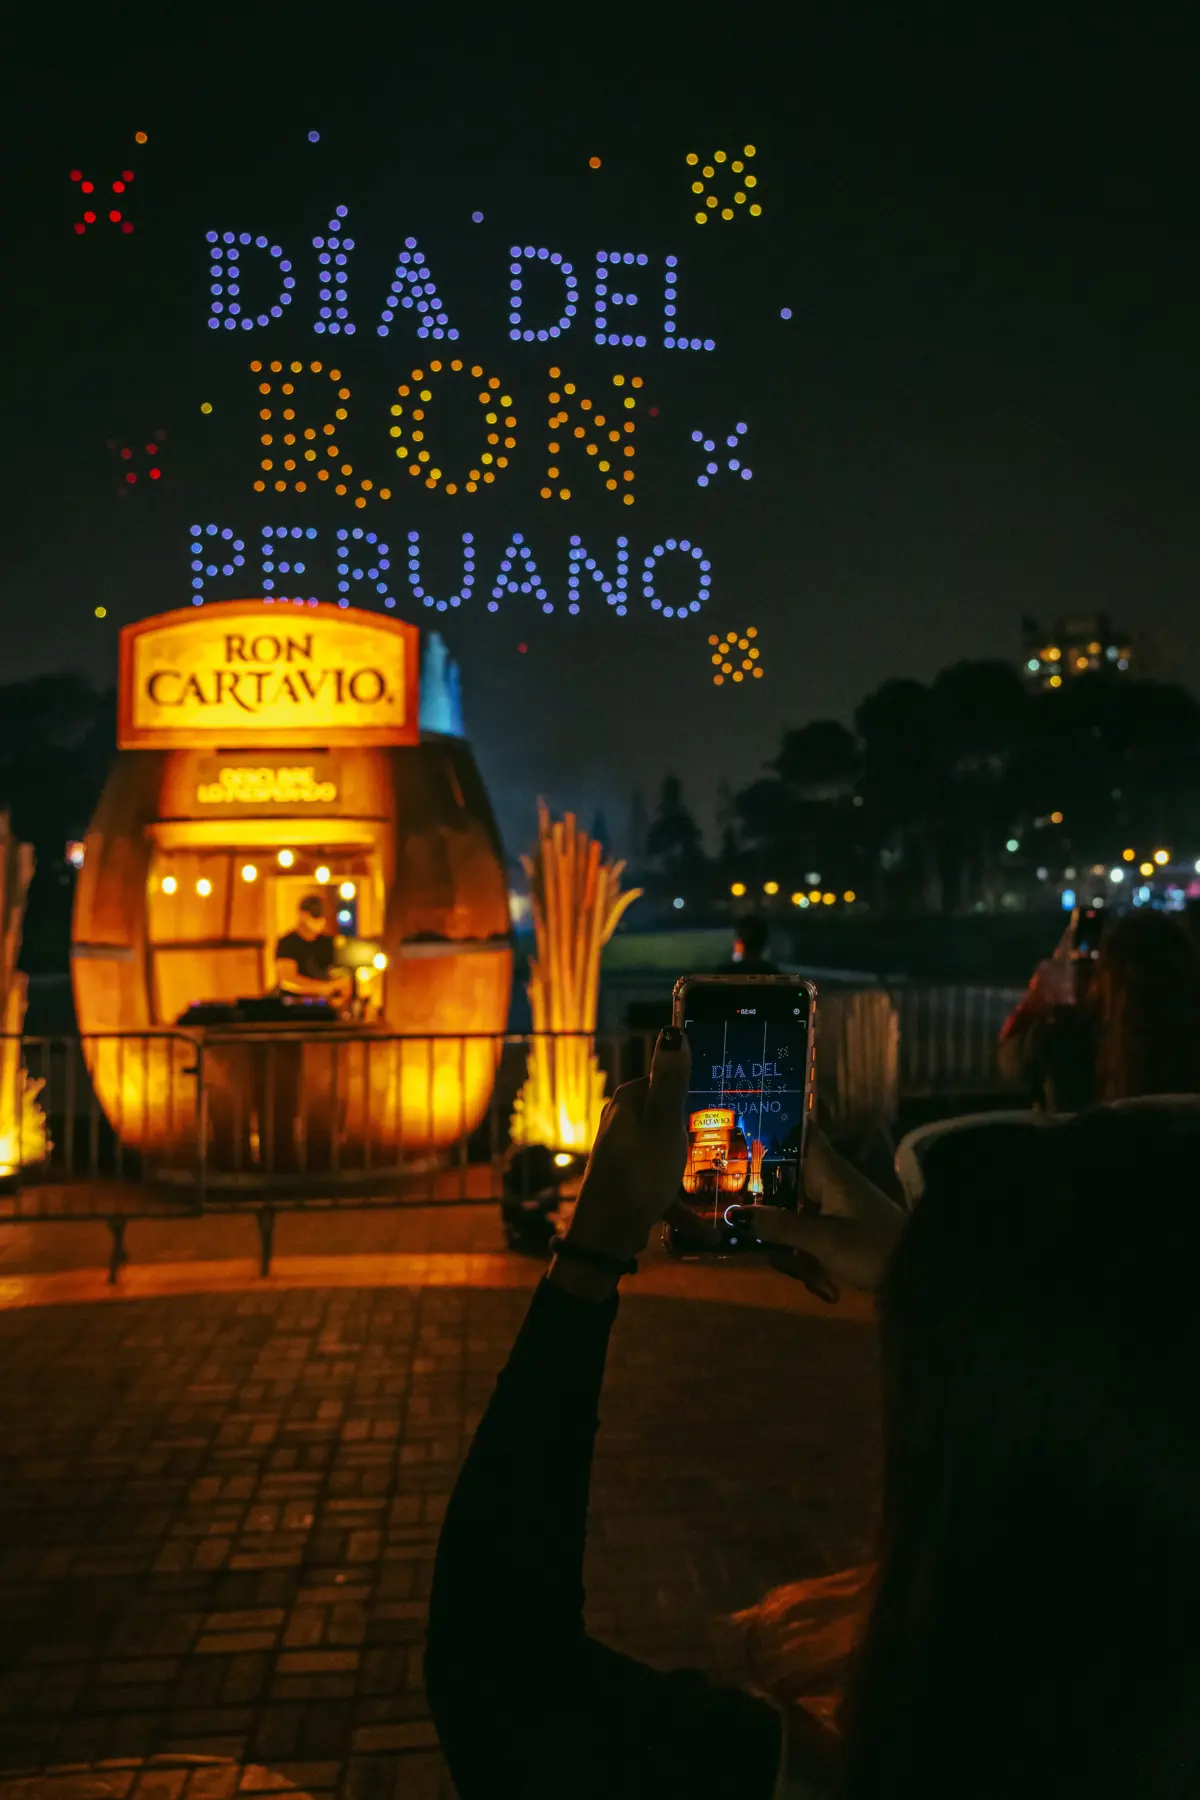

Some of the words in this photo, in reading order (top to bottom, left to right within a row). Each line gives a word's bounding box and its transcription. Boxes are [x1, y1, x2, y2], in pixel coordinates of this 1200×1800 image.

[206, 205, 459, 340] DÍA
[509, 245, 716, 351] DEL
[250, 359, 644, 509] RON
[190, 523, 713, 618] PERUANO
[223, 633, 315, 664] RON
[711, 1060, 746, 1078] DÍA
[752, 1062, 782, 1077] DEL
